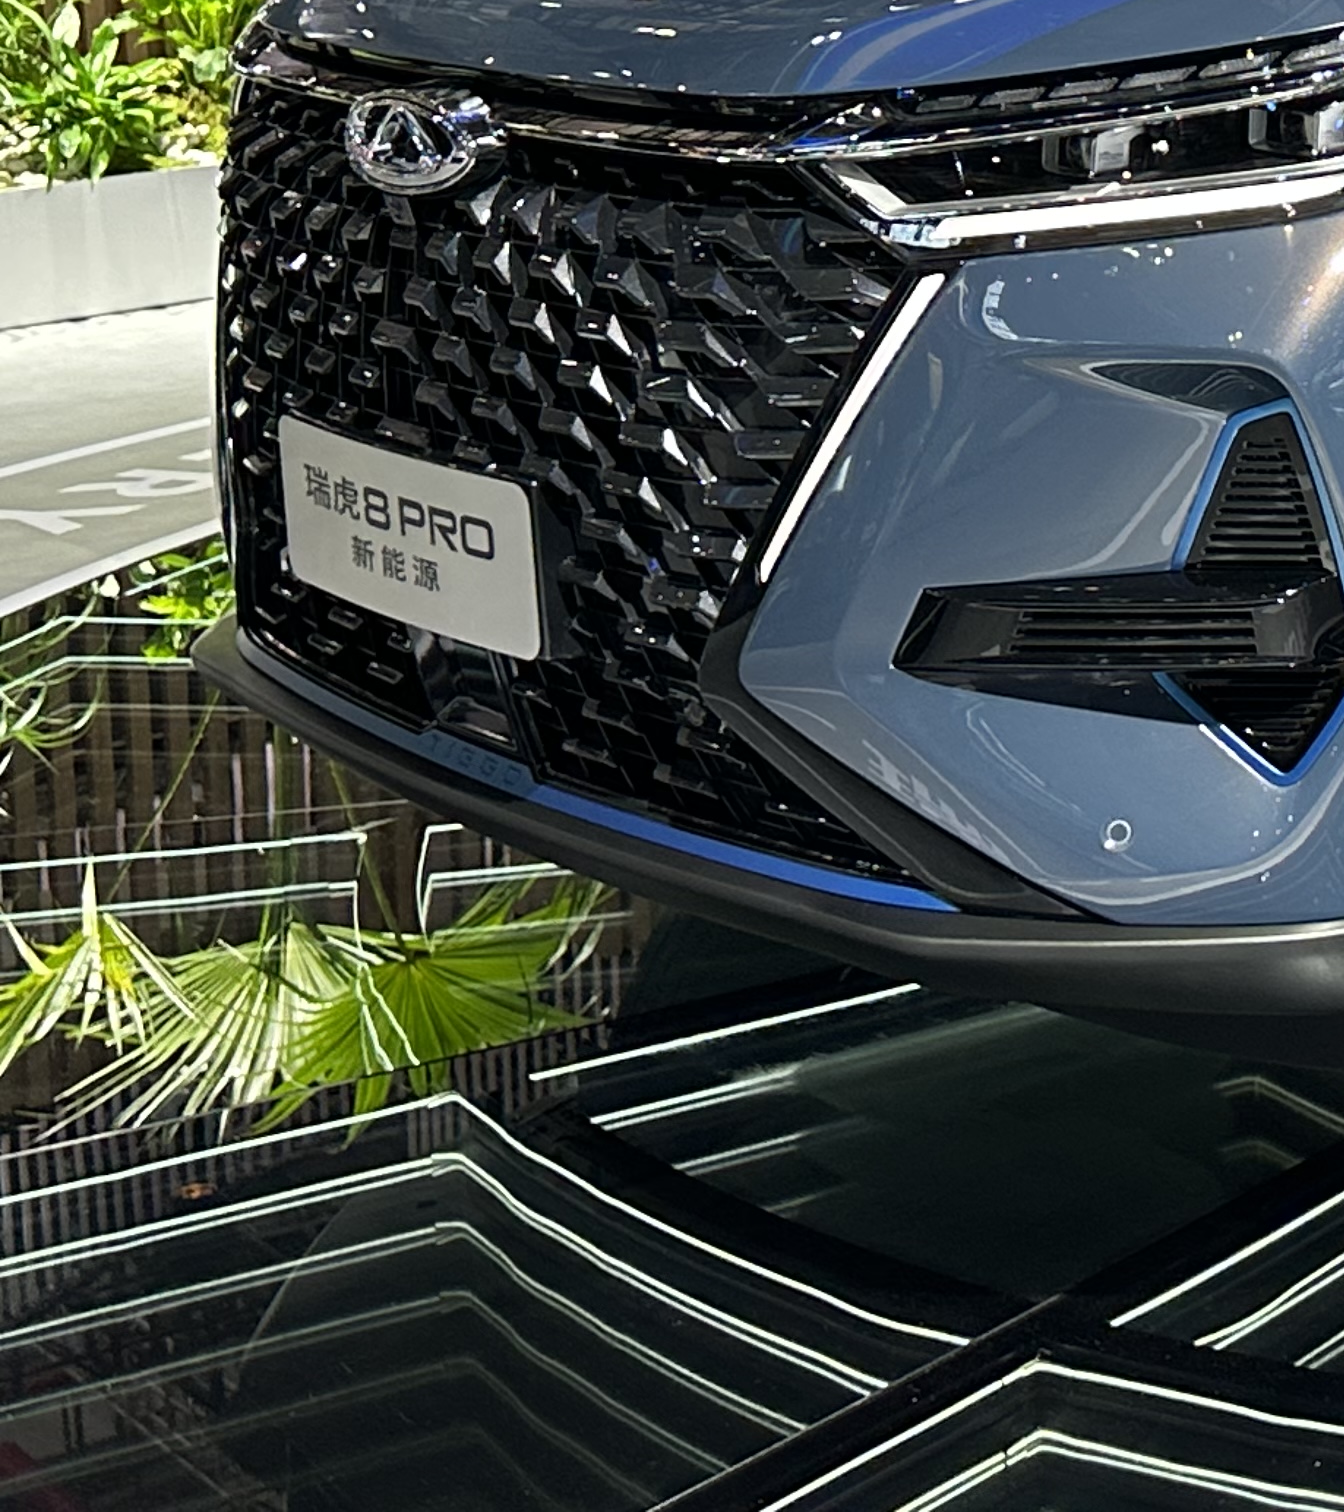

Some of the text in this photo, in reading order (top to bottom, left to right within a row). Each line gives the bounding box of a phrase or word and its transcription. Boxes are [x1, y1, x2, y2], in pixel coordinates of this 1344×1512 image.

[303, 463, 495, 561] 瑞虎8 PRO
[351, 535, 441, 592] 新能源
